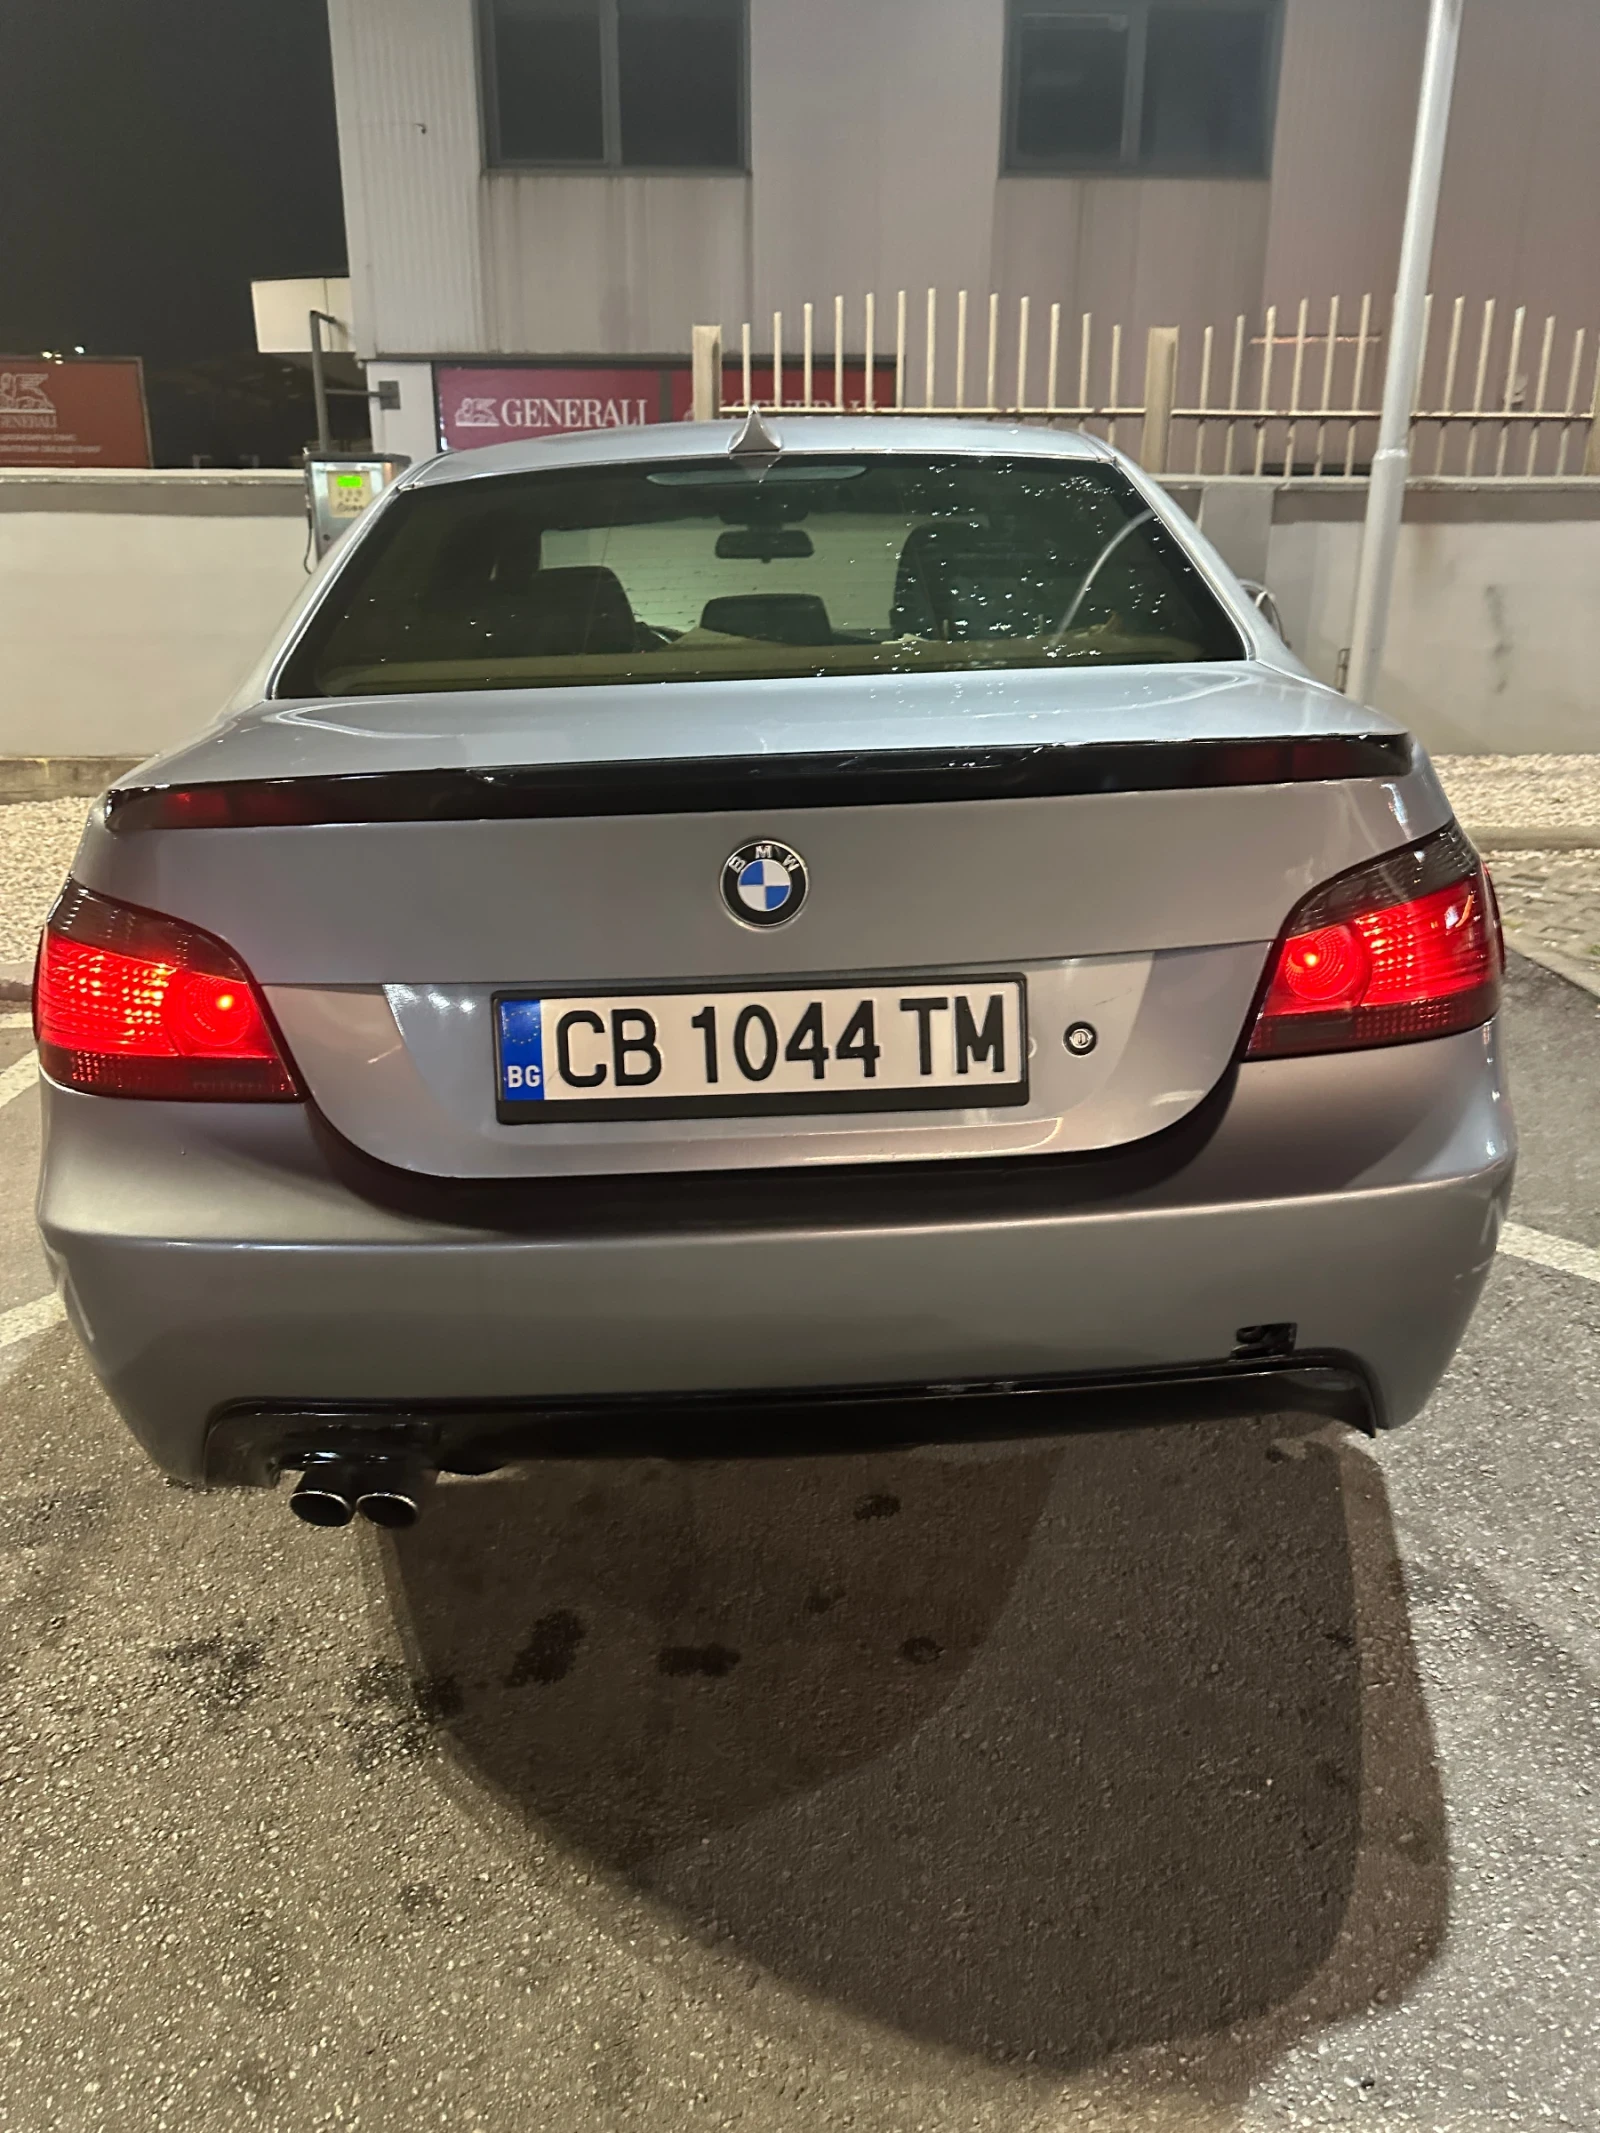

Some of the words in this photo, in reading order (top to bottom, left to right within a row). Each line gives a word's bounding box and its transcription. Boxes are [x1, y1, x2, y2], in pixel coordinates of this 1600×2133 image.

[501, 398, 648, 427] GENERALI
[728, 845, 800, 873] BMW
[556, 1009, 663, 1088] CB
[691, 1000, 880, 1083] 1044
[900, 994, 1005, 1076] TM
[507, 1065, 541, 1088] BG
